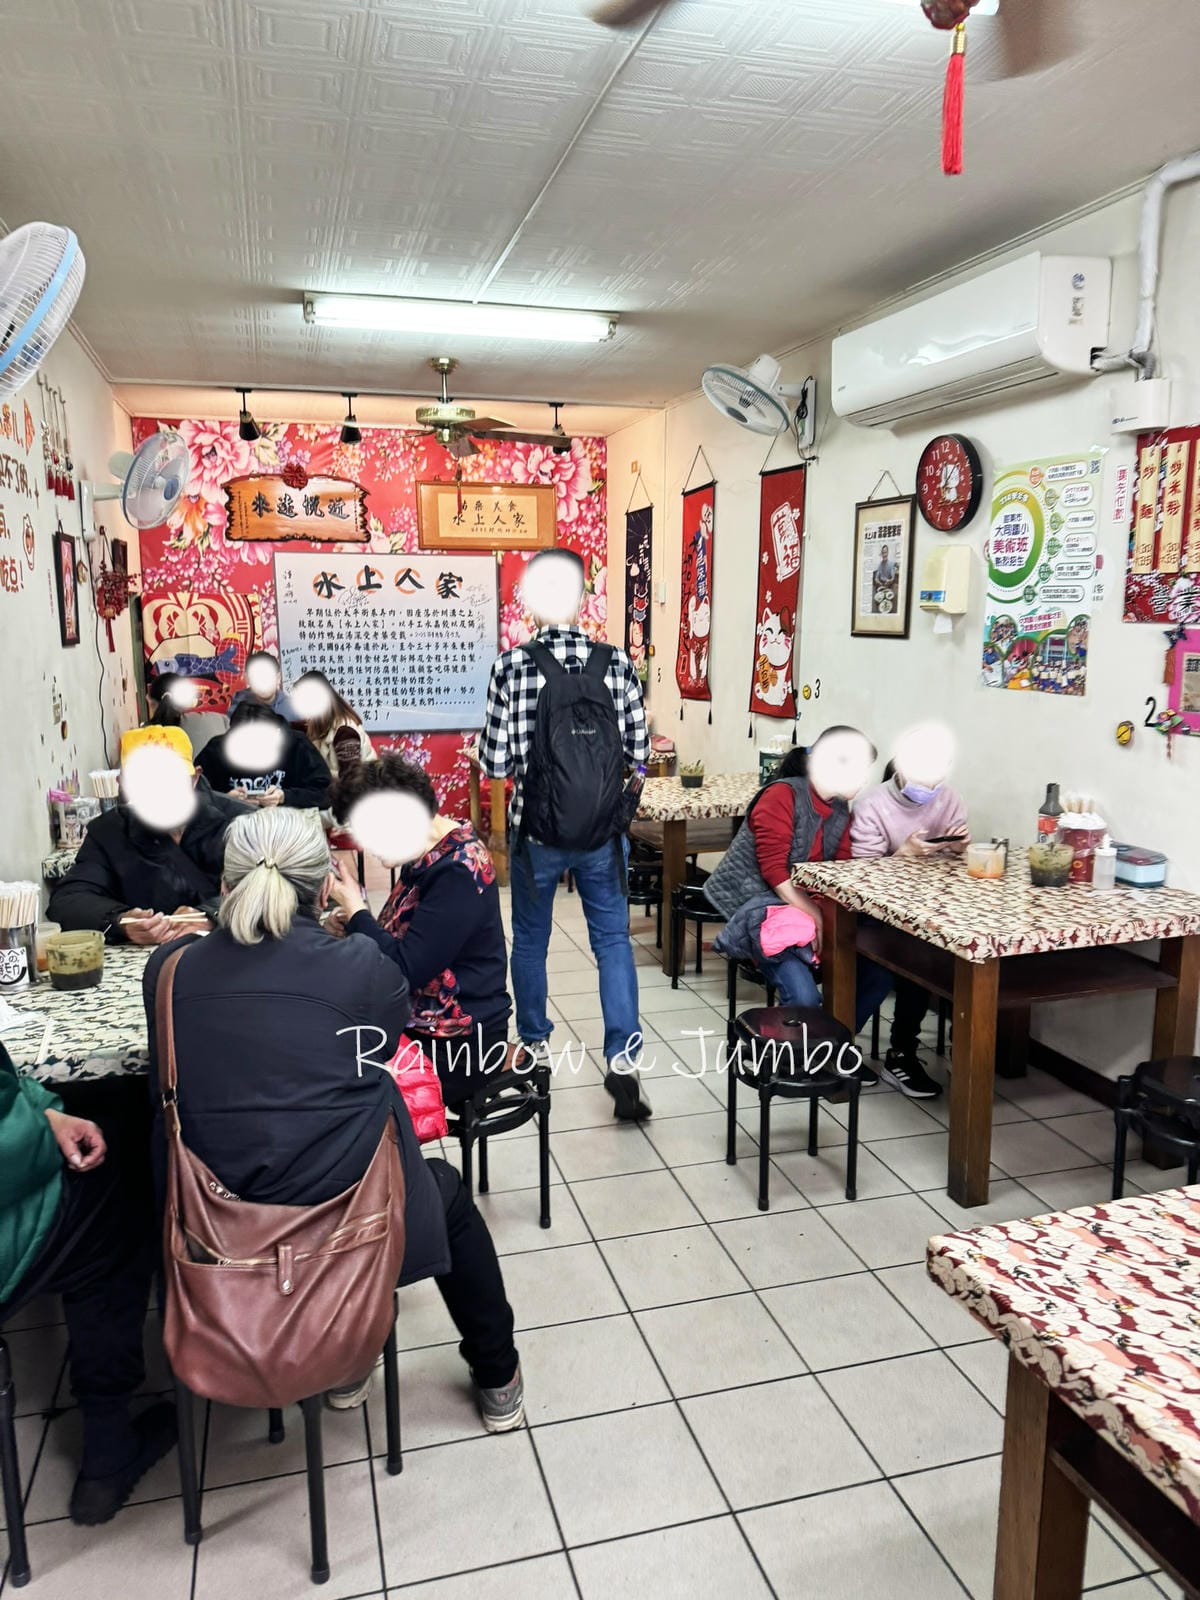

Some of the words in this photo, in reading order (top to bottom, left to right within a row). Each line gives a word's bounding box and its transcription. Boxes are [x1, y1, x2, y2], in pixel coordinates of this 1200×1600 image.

[941, 441, 950, 453] 12
[956, 444, 960, 454] 1
[932, 449, 940, 460] 11
[925, 465, 934, 477] 10
[923, 484, 929, 494] 9
[1166, 462, 1184, 517] 炒米粉
[927, 500, 933, 511] 8
[936, 511, 942, 522] 7
[959, 507, 965, 519] 5
[947, 515, 953, 526] 6
[994, 523, 1030, 537] 大同國小
[993, 537, 1030, 554] 美術班
[313, 564, 463, 599] 水上人家
[814, 679, 821, 699] 3
[1144, 696, 1158, 728] 2
